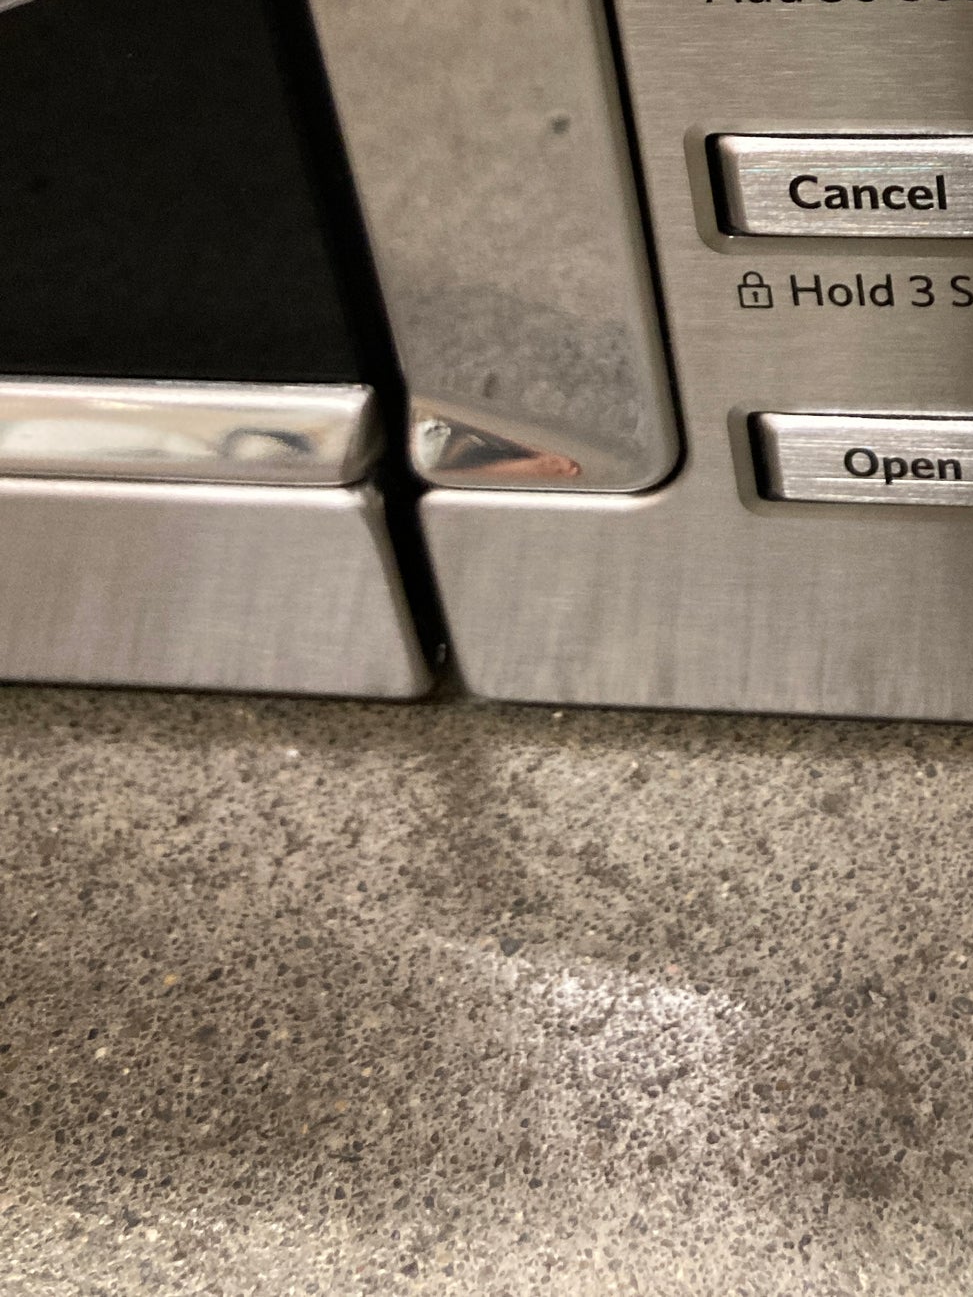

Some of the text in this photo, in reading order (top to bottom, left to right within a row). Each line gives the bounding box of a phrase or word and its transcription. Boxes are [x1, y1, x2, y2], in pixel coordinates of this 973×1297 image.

[788, 174, 948, 211] Cancel
[789, 272, 895, 308] Hold
[908, 274, 936, 308] 3
[843, 447, 963, 484] Open
